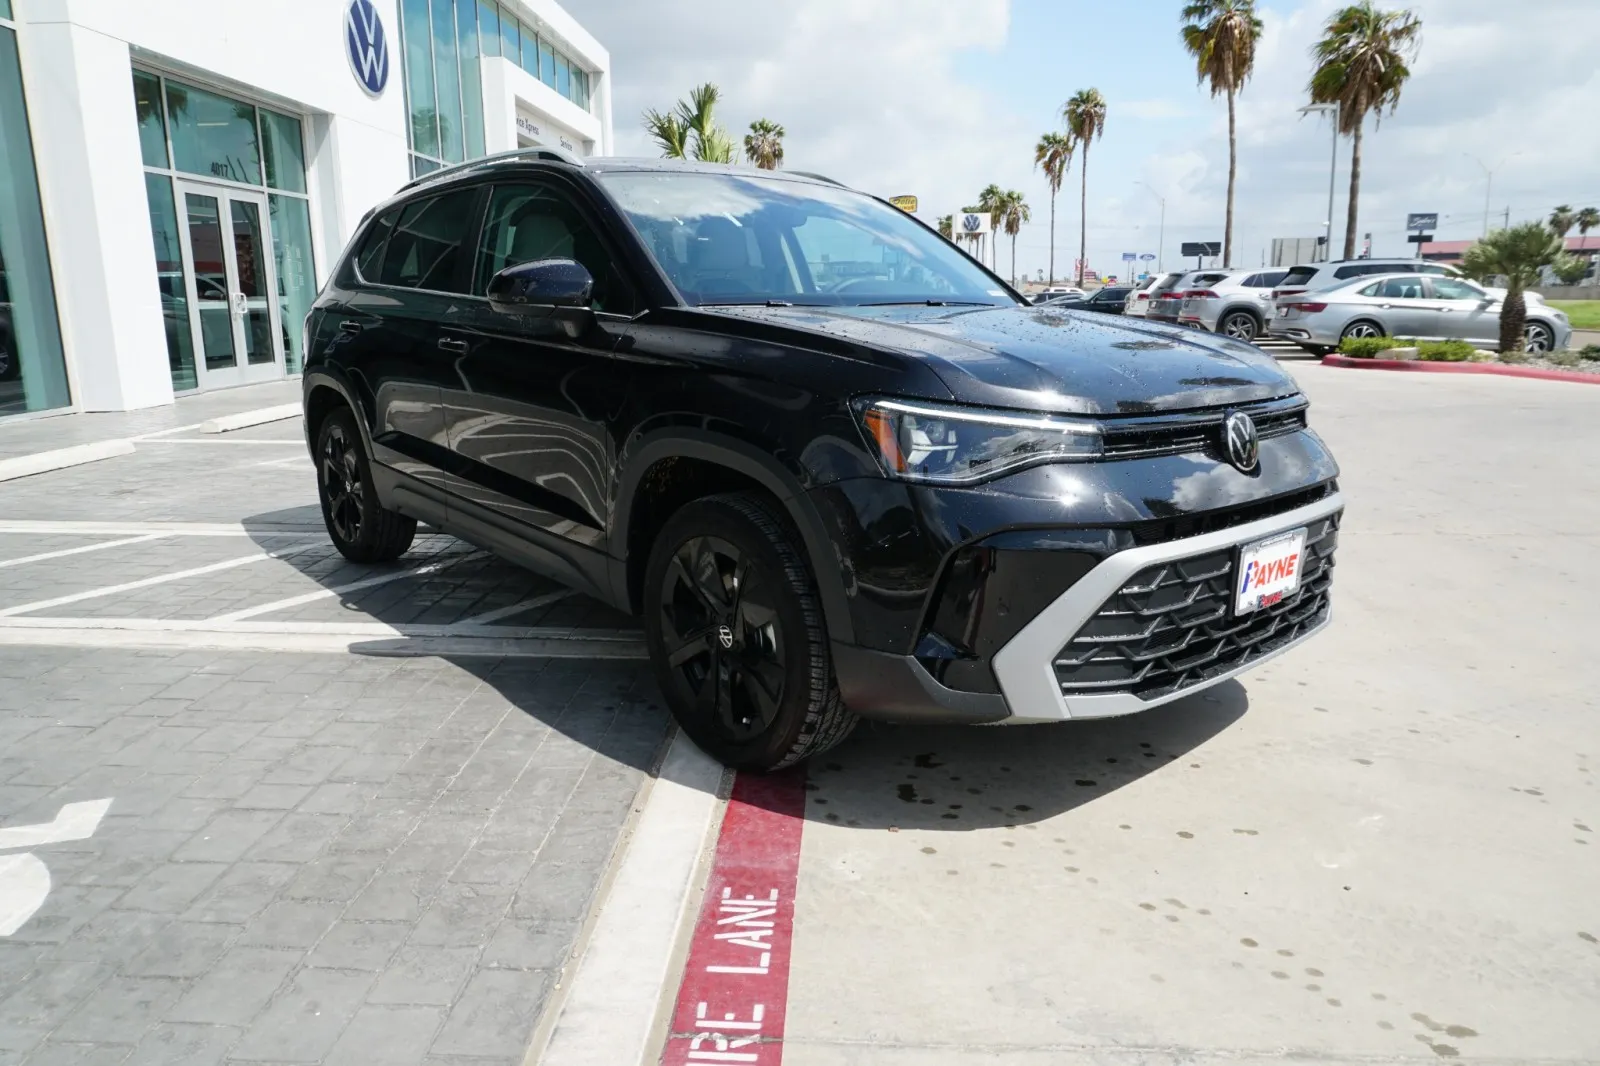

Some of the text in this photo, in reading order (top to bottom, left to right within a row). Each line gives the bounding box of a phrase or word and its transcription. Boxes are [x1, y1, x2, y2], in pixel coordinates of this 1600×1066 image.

[560, 136, 573, 152] Service
[210, 161, 229, 178] 4017
[1241, 553, 1298, 594] PAYNE
[685, 887, 779, 1066] RE LANE
